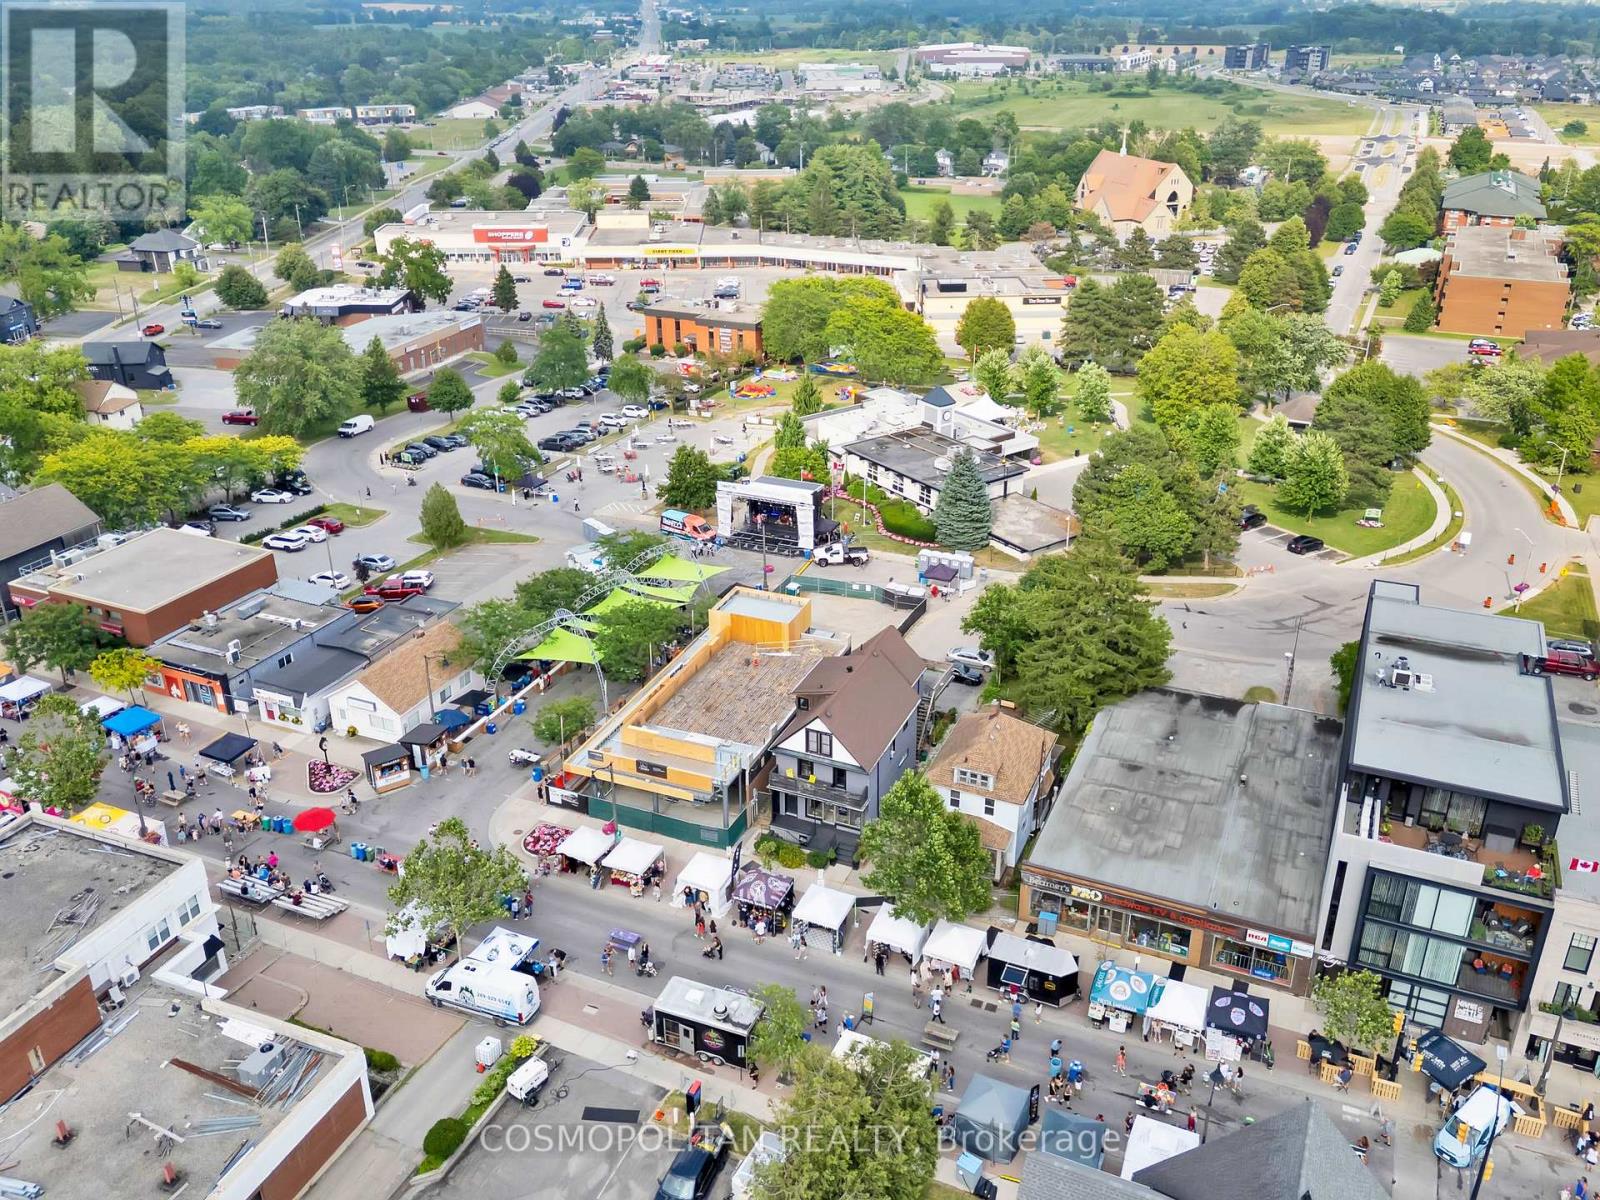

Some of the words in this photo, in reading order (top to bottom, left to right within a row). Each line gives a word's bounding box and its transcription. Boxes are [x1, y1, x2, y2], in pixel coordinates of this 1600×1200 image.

[1071, 885, 1103, 901] PRO
[1153, 906, 1168, 916] TV
[1248, 933, 1267, 943] RCA
